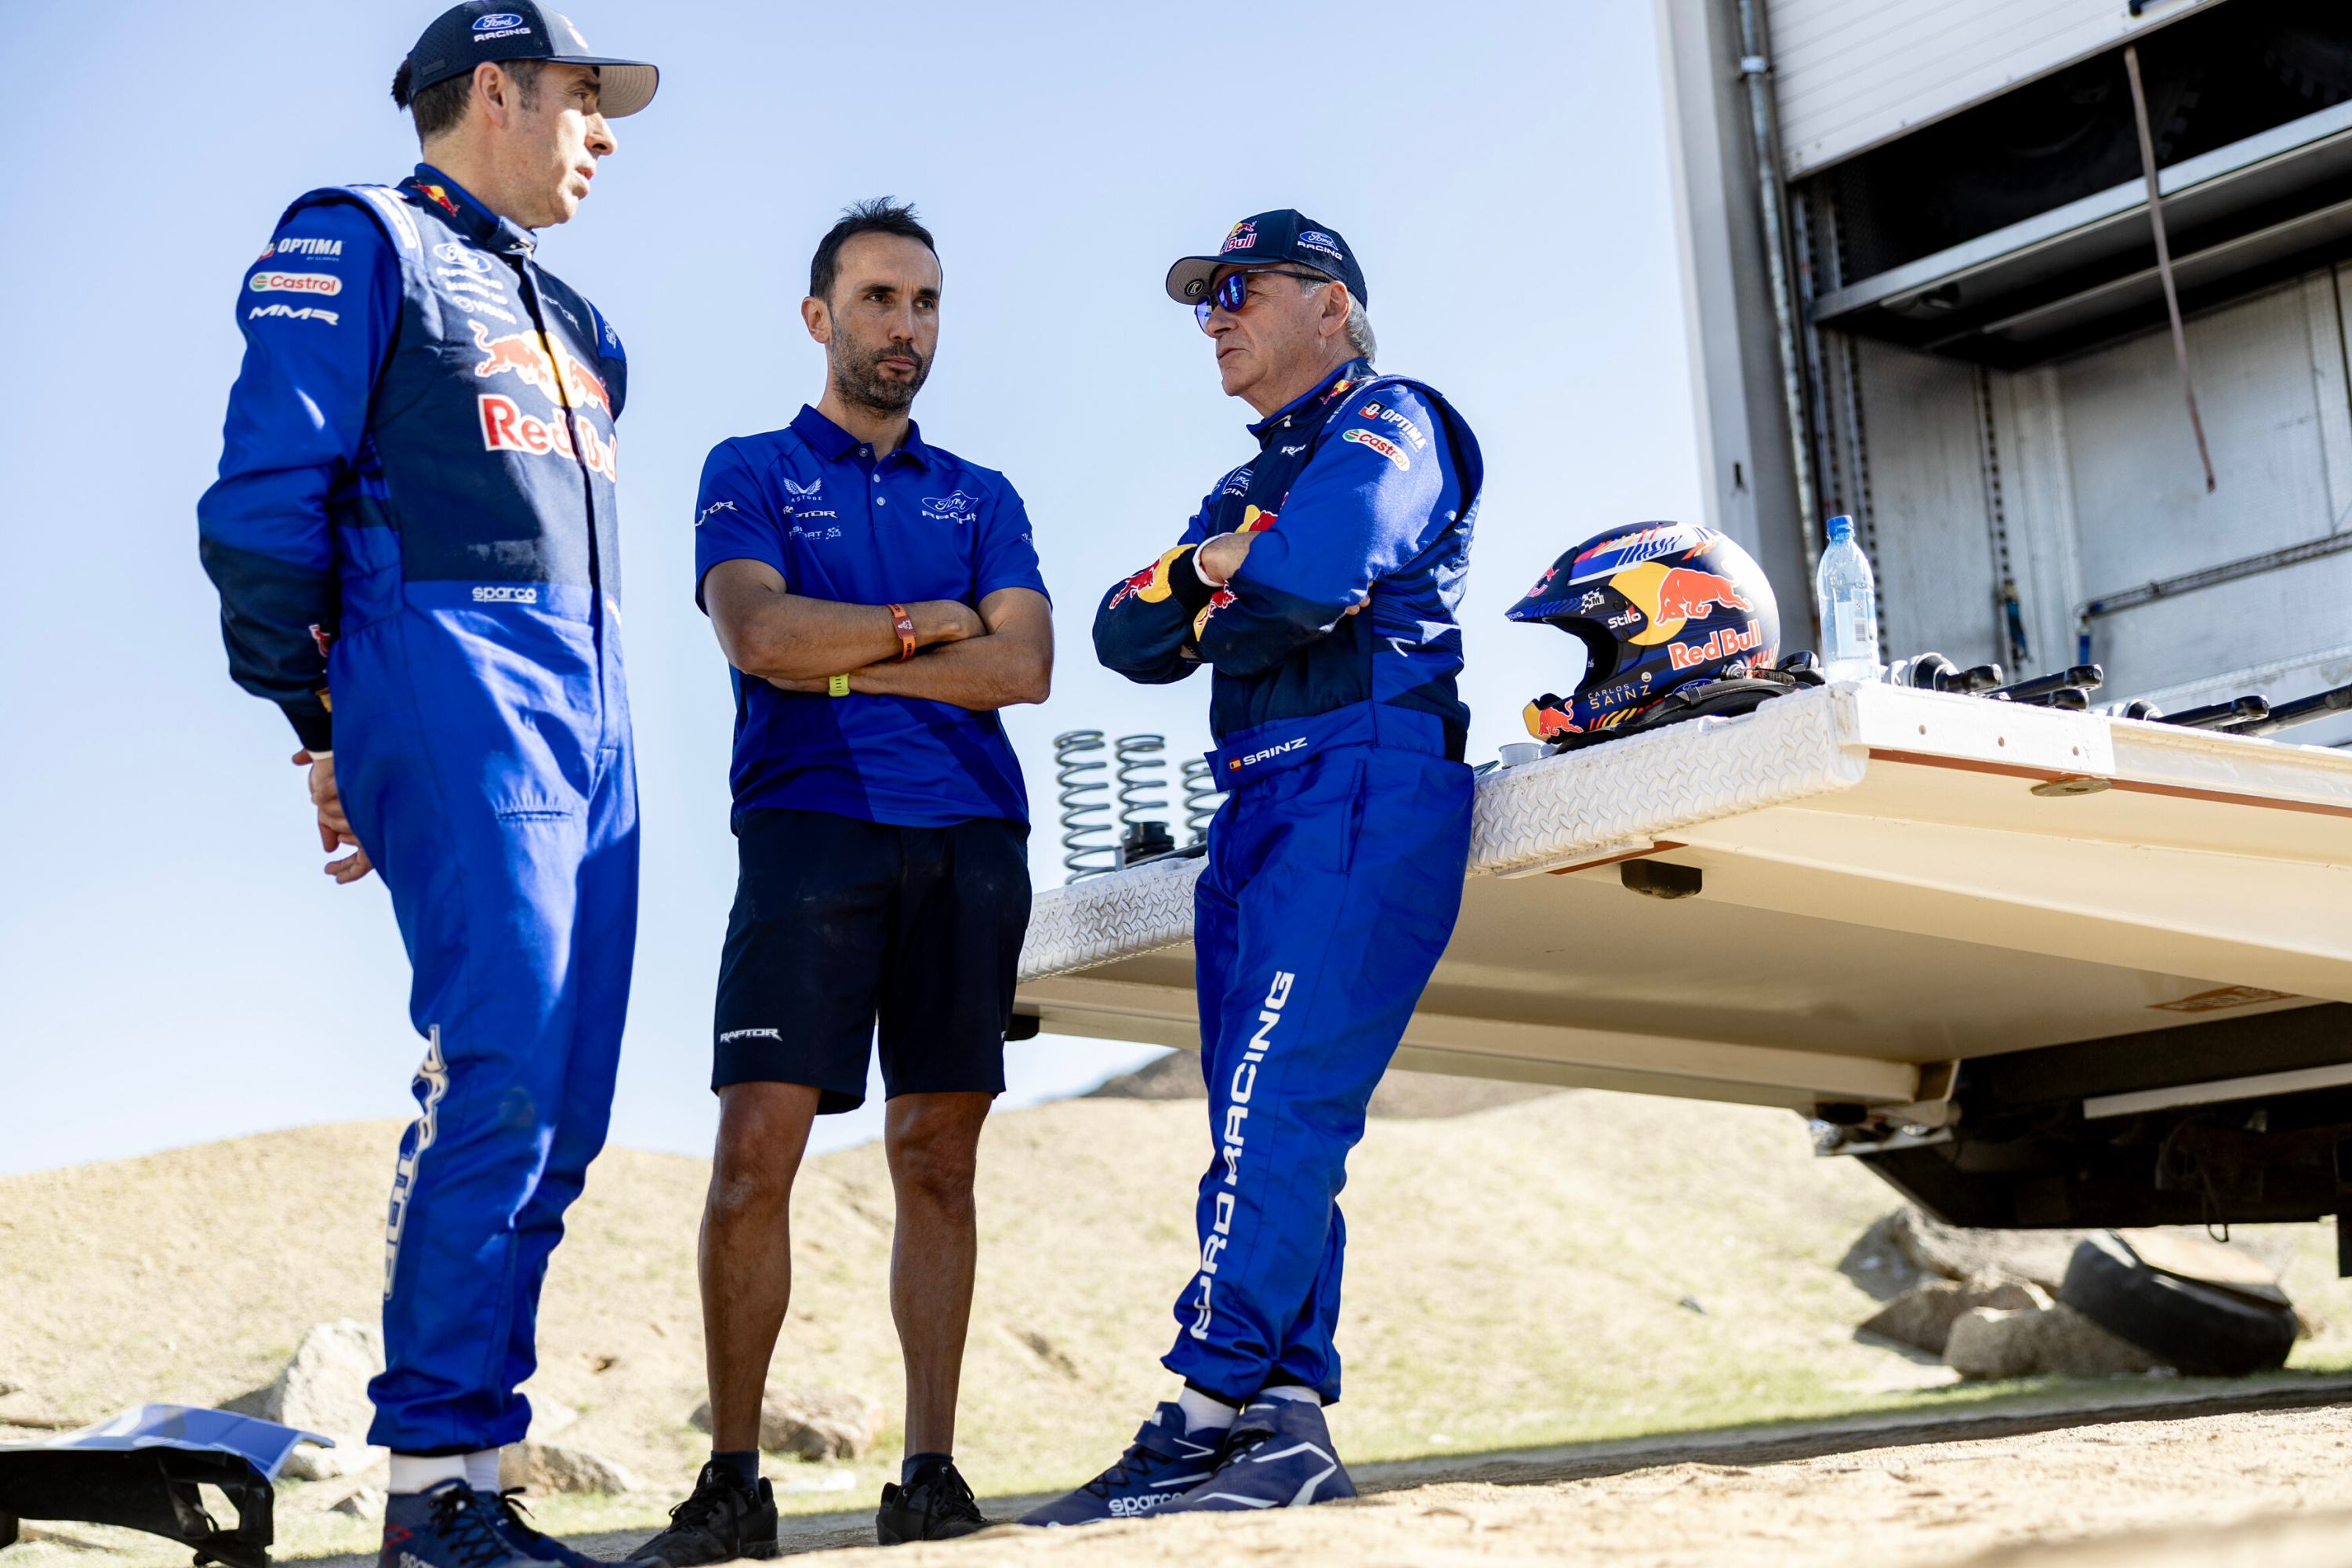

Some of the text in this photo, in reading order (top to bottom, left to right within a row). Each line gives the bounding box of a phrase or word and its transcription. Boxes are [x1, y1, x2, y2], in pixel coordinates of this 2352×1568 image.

[482, 15, 514, 27] Ford
[474, 27, 532, 42] RACING
[278, 238, 343, 256] OPTIMA
[1225, 233, 1258, 252] Bull
[1308, 232, 1334, 247] Ford
[1297, 241, 1343, 261] RACING
[270, 275, 336, 292] Castrol
[248, 304, 339, 325] MMR
[479, 394, 577, 460] Red
[1380, 408, 1427, 450] OPTIMA
[1359, 434, 1408, 467] Castrol
[472, 586, 537, 604] sparco
[1668, 619, 1762, 671] Red Bull
[1588, 683, 1630, 699] CARLOS
[1589, 684, 1651, 710] SAINZ
[1243, 737, 1308, 766] SAINZ
[720, 1028, 782, 1044] RAPTOR
[1189, 971, 1295, 1341] FORD RACING
